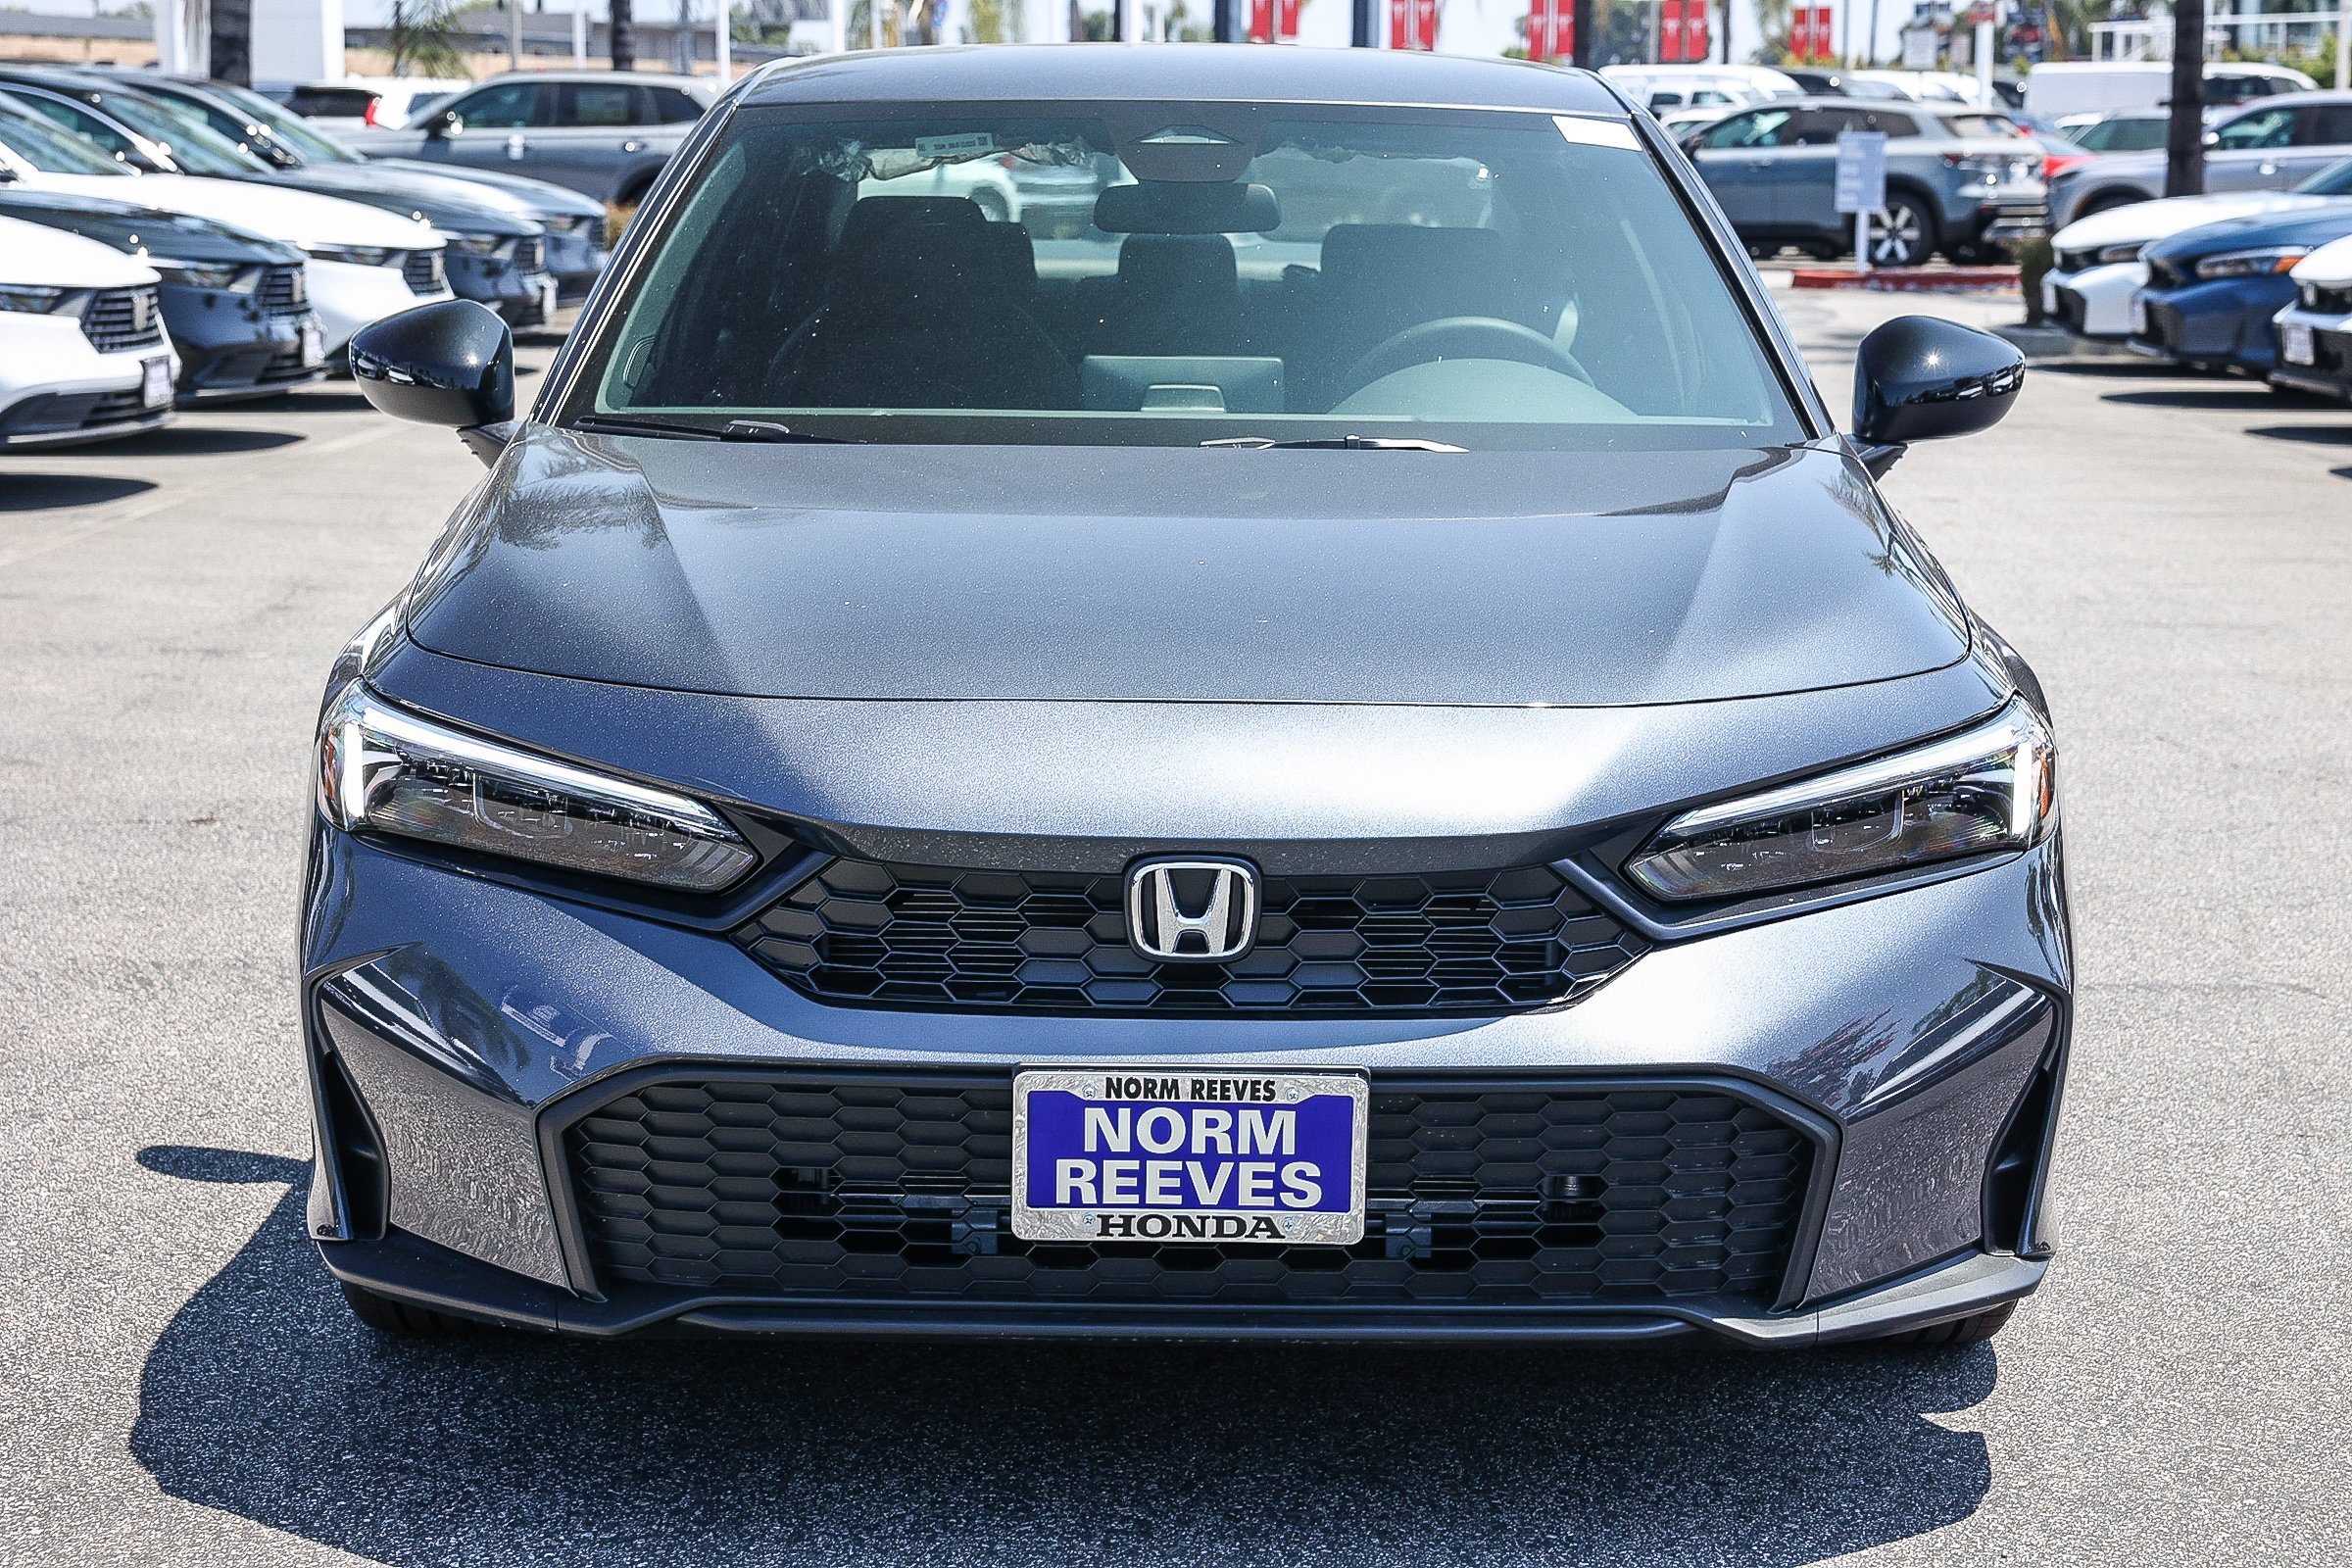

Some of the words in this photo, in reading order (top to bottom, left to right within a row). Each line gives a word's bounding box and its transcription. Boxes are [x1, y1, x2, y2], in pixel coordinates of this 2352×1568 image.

[1105, 1077, 1181, 1100] NORM
[1191, 1078, 1276, 1102] REEVES
[1084, 1106, 1297, 1155] NORM
[1055, 1158, 1322, 1208] REEVES
[1097, 1213, 1286, 1239] HONDA
